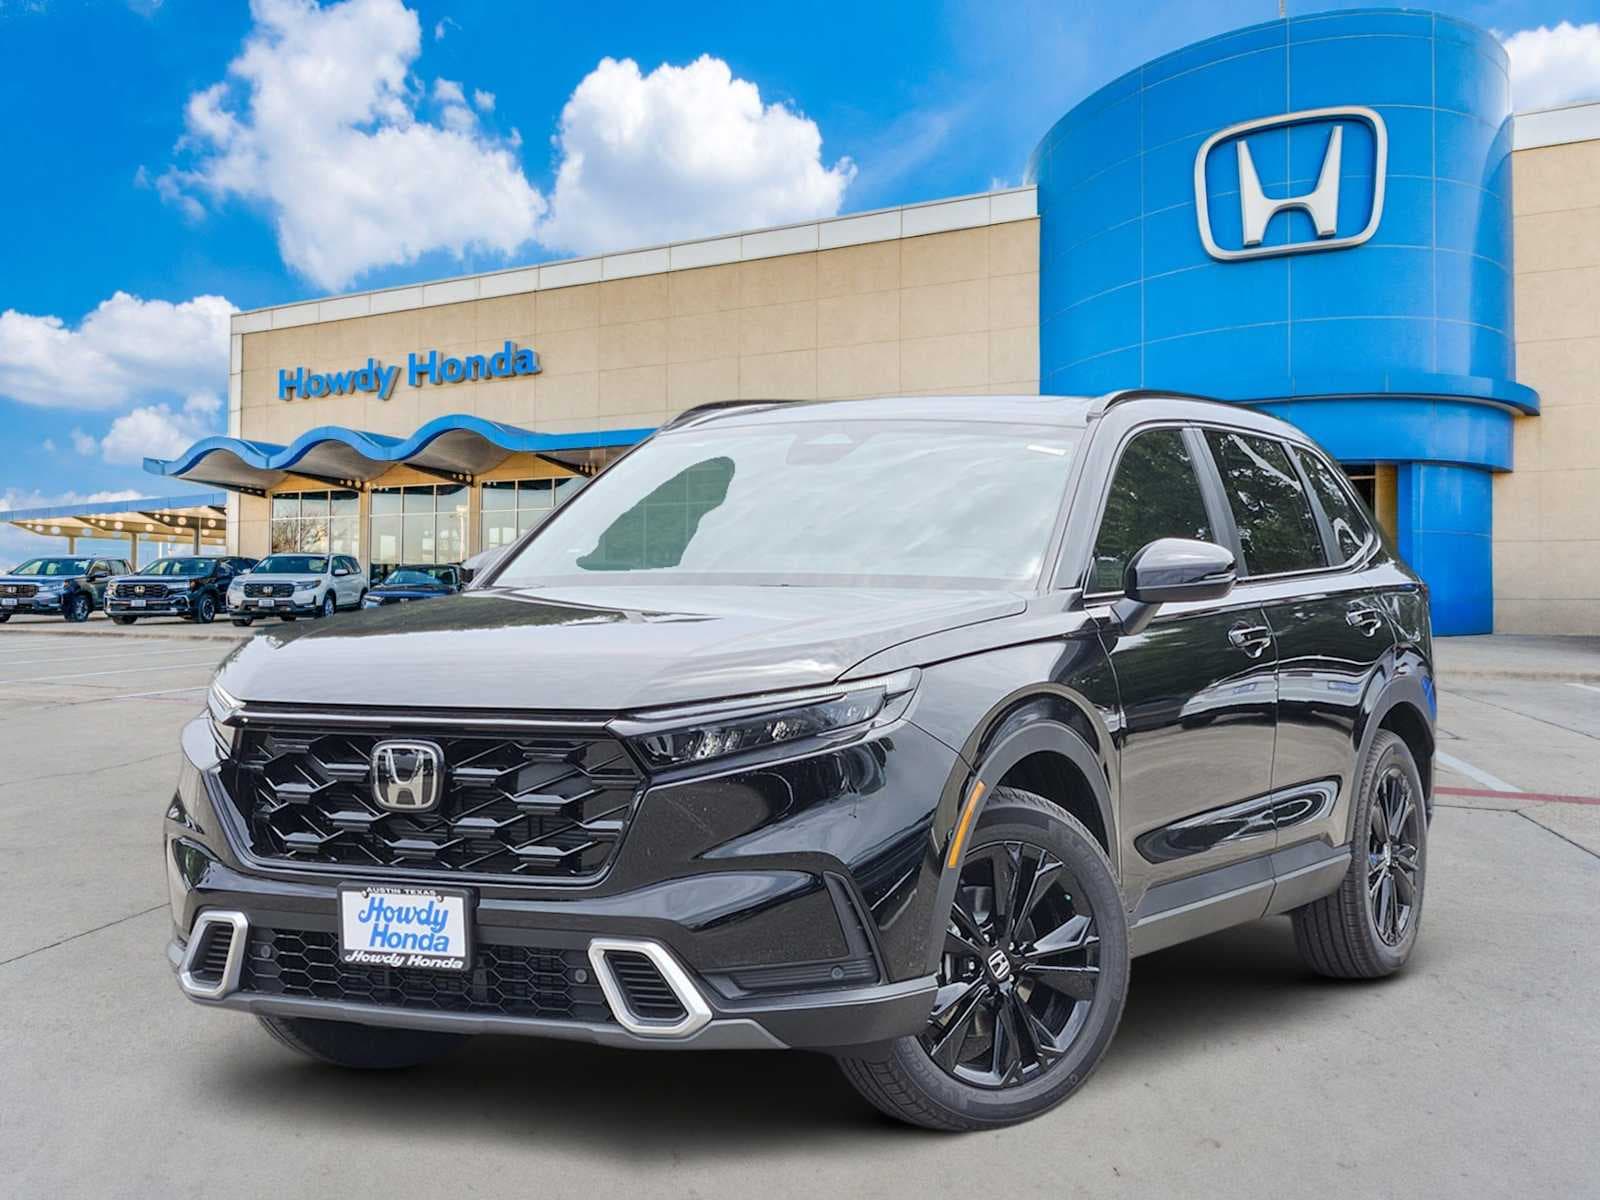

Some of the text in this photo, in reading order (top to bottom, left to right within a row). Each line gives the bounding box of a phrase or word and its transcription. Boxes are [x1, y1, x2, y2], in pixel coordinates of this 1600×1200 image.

[278, 340, 541, 401] Howdy Honda
[404, 889, 436, 897] TEXAS
[358, 896, 449, 933] Howdy
[369, 922, 450, 953] Honda
[345, 950, 464, 969] Howdy Honda
